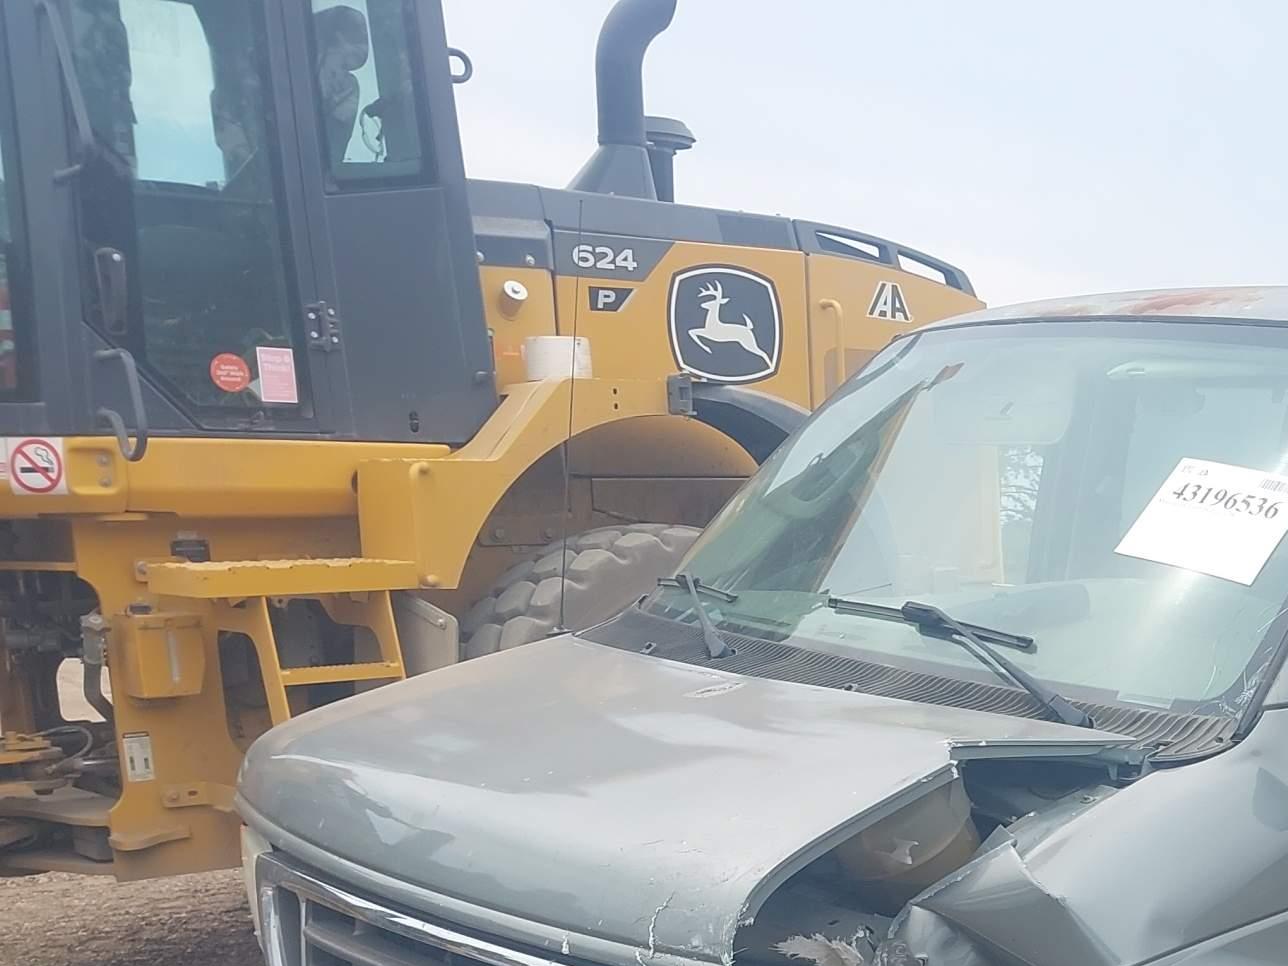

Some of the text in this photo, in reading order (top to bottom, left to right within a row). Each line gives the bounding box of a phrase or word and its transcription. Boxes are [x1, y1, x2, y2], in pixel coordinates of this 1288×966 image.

[572, 244, 638, 271] 624
[597, 289, 617, 309] P
[1172, 482, 1285, 519] 43196536
